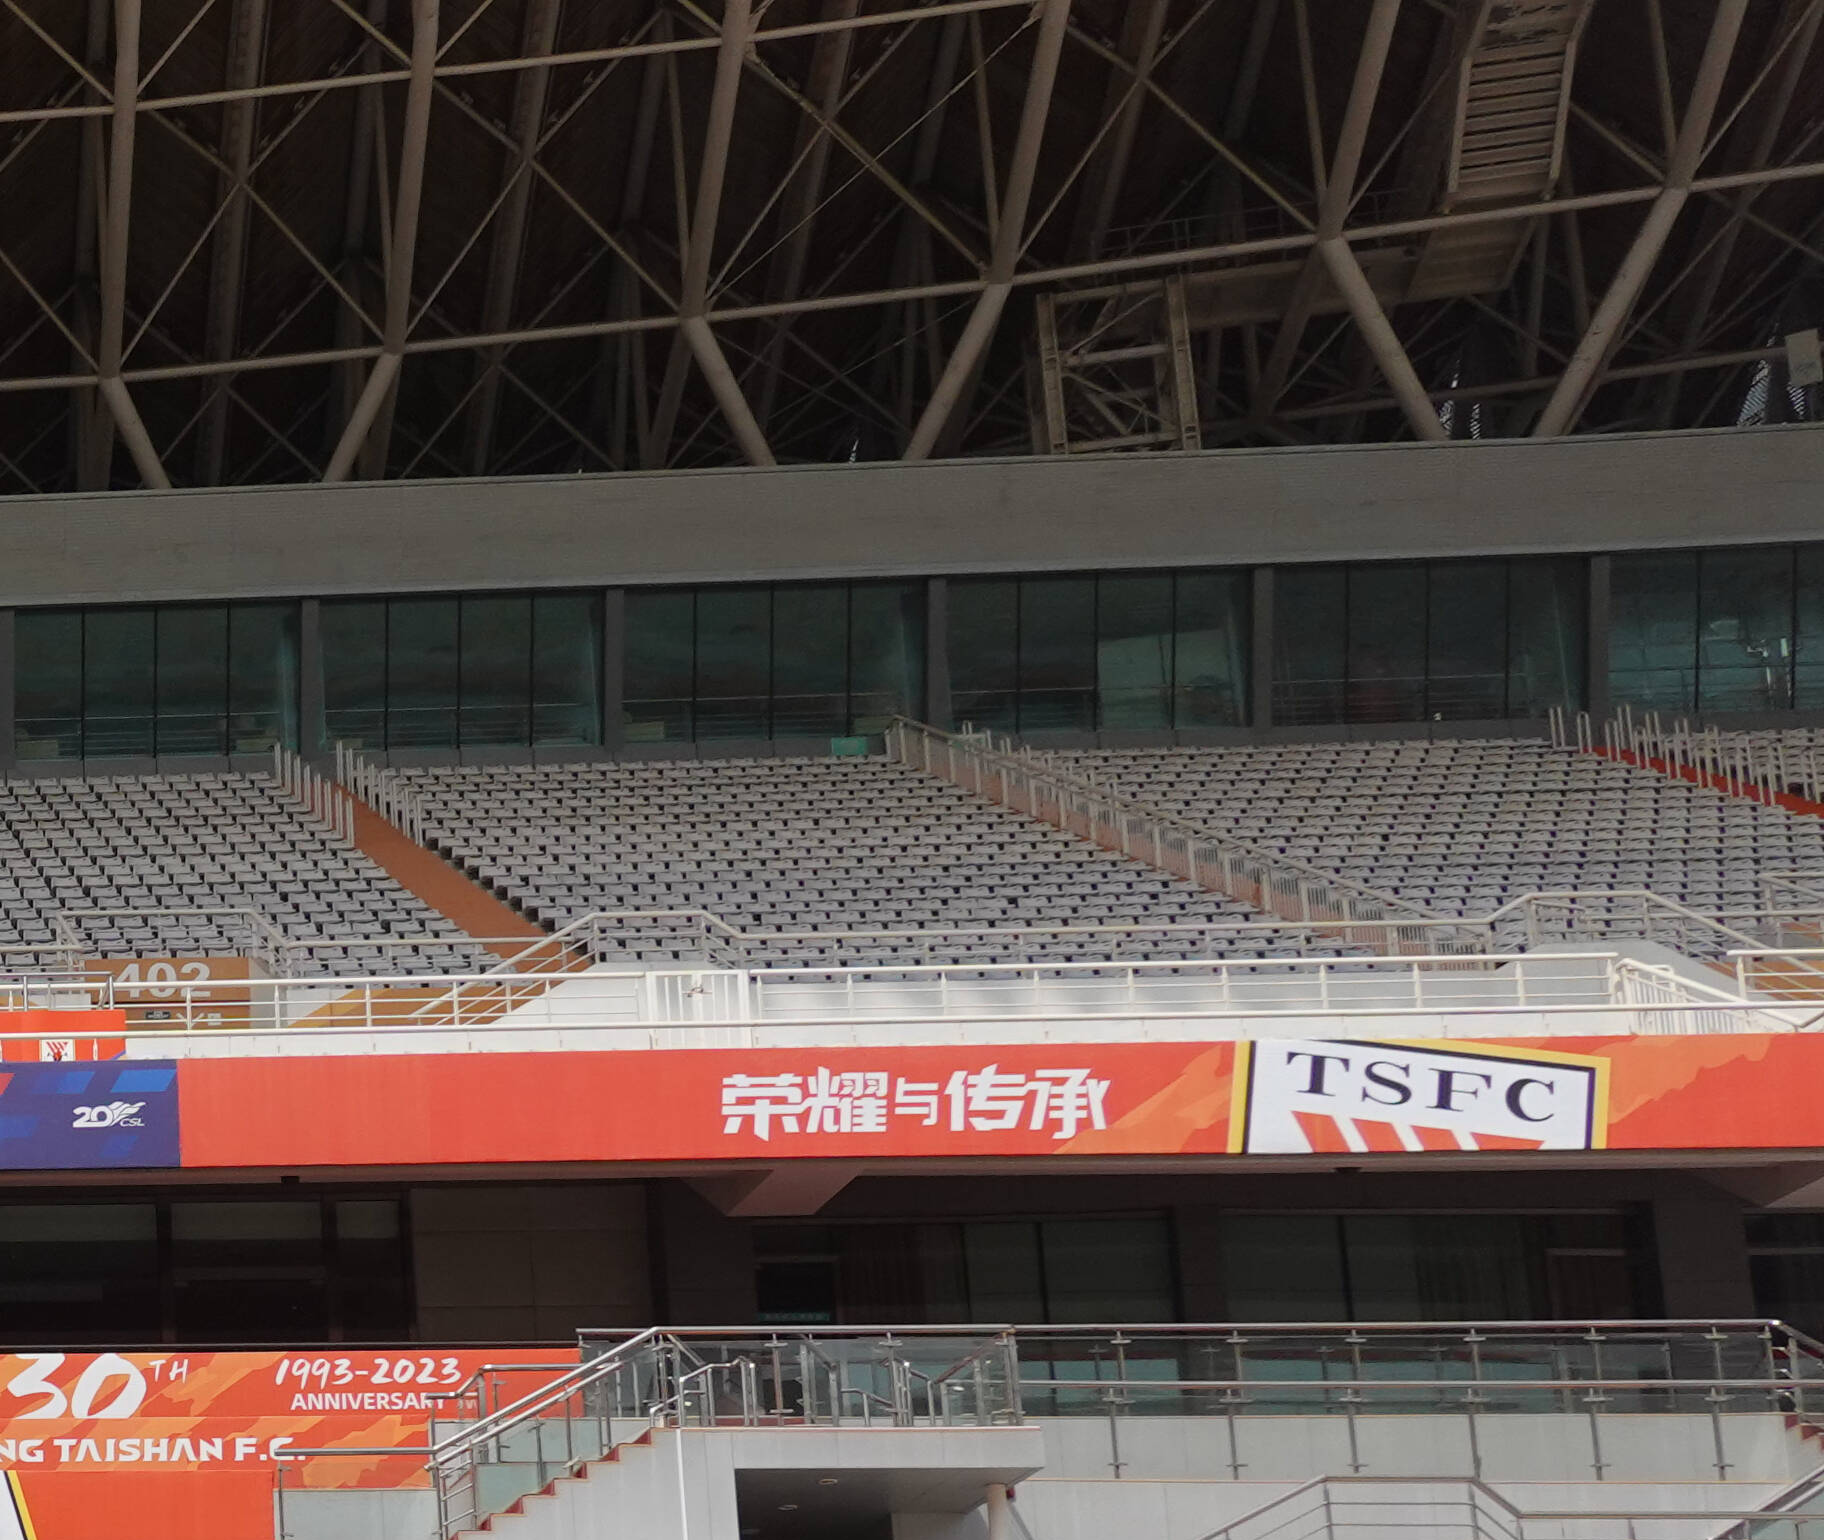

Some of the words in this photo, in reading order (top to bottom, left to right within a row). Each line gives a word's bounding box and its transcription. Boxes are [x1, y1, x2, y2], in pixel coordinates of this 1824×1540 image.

[116, 962, 211, 998] 402
[721, 1064, 1108, 1141] 荣耀与传承
[1286, 1051, 1555, 1122] TSFC
[119, 1117, 145, 1127] CSL
[8, 1353, 147, 1419] 30
[148, 1358, 189, 1384] TH
[275, 1356, 462, 1388] 1993-2023
[53, 1437, 228, 1463] TAISHAN
[234, 1436, 306, 1462] F.C.
